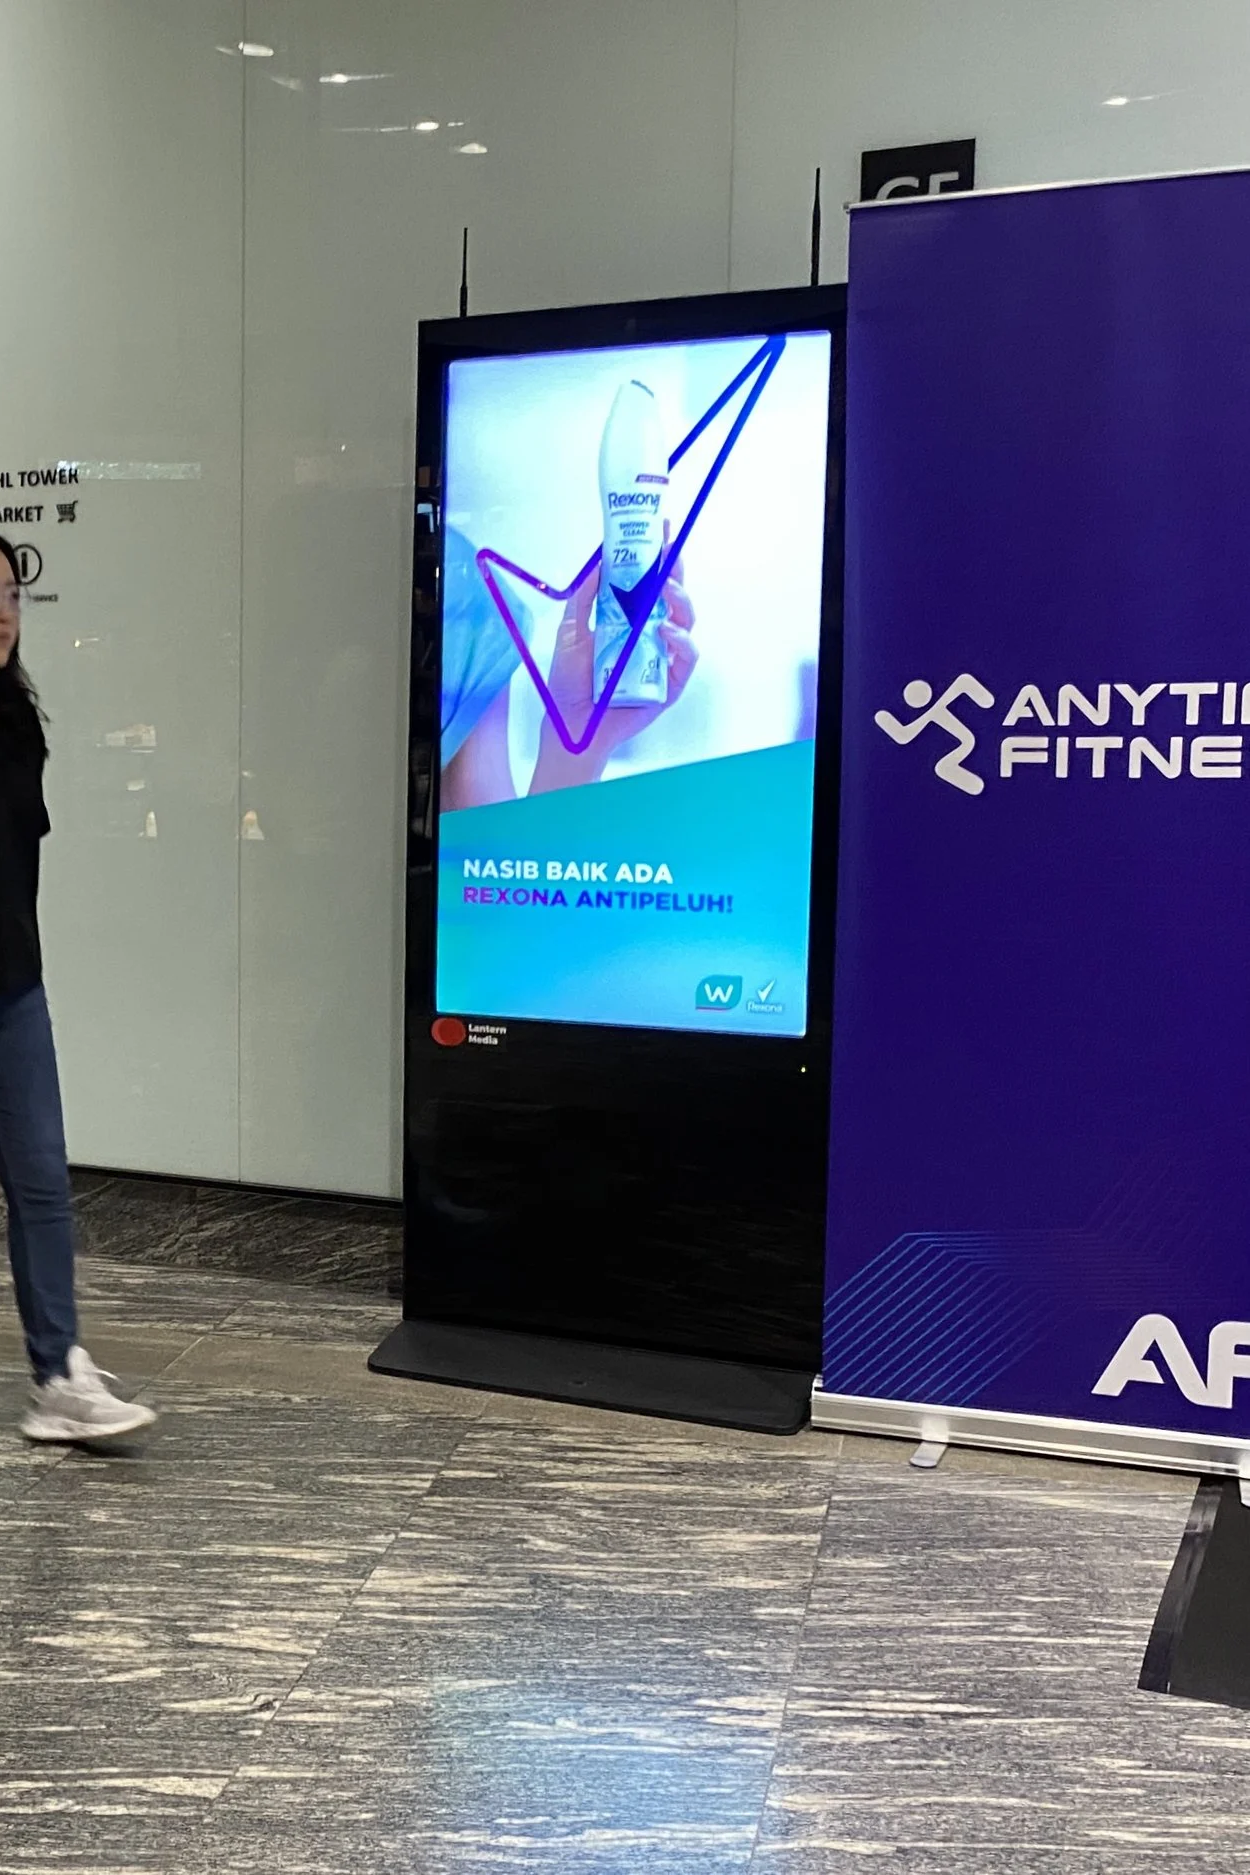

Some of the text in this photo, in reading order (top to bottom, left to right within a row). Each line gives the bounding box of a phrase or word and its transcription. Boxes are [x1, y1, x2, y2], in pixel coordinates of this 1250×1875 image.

[18, 468, 79, 487] TOWER
[1002, 682, 1250, 726] ANYTI
[463, 859, 674, 884] NASIB BAIK ADA
[463, 886, 734, 914] REXONA ANTIPELUH!
[704, 983, 734, 1003] W
[468, 1023, 507, 1034] Lantern
[468, 1035, 499, 1045] Media
